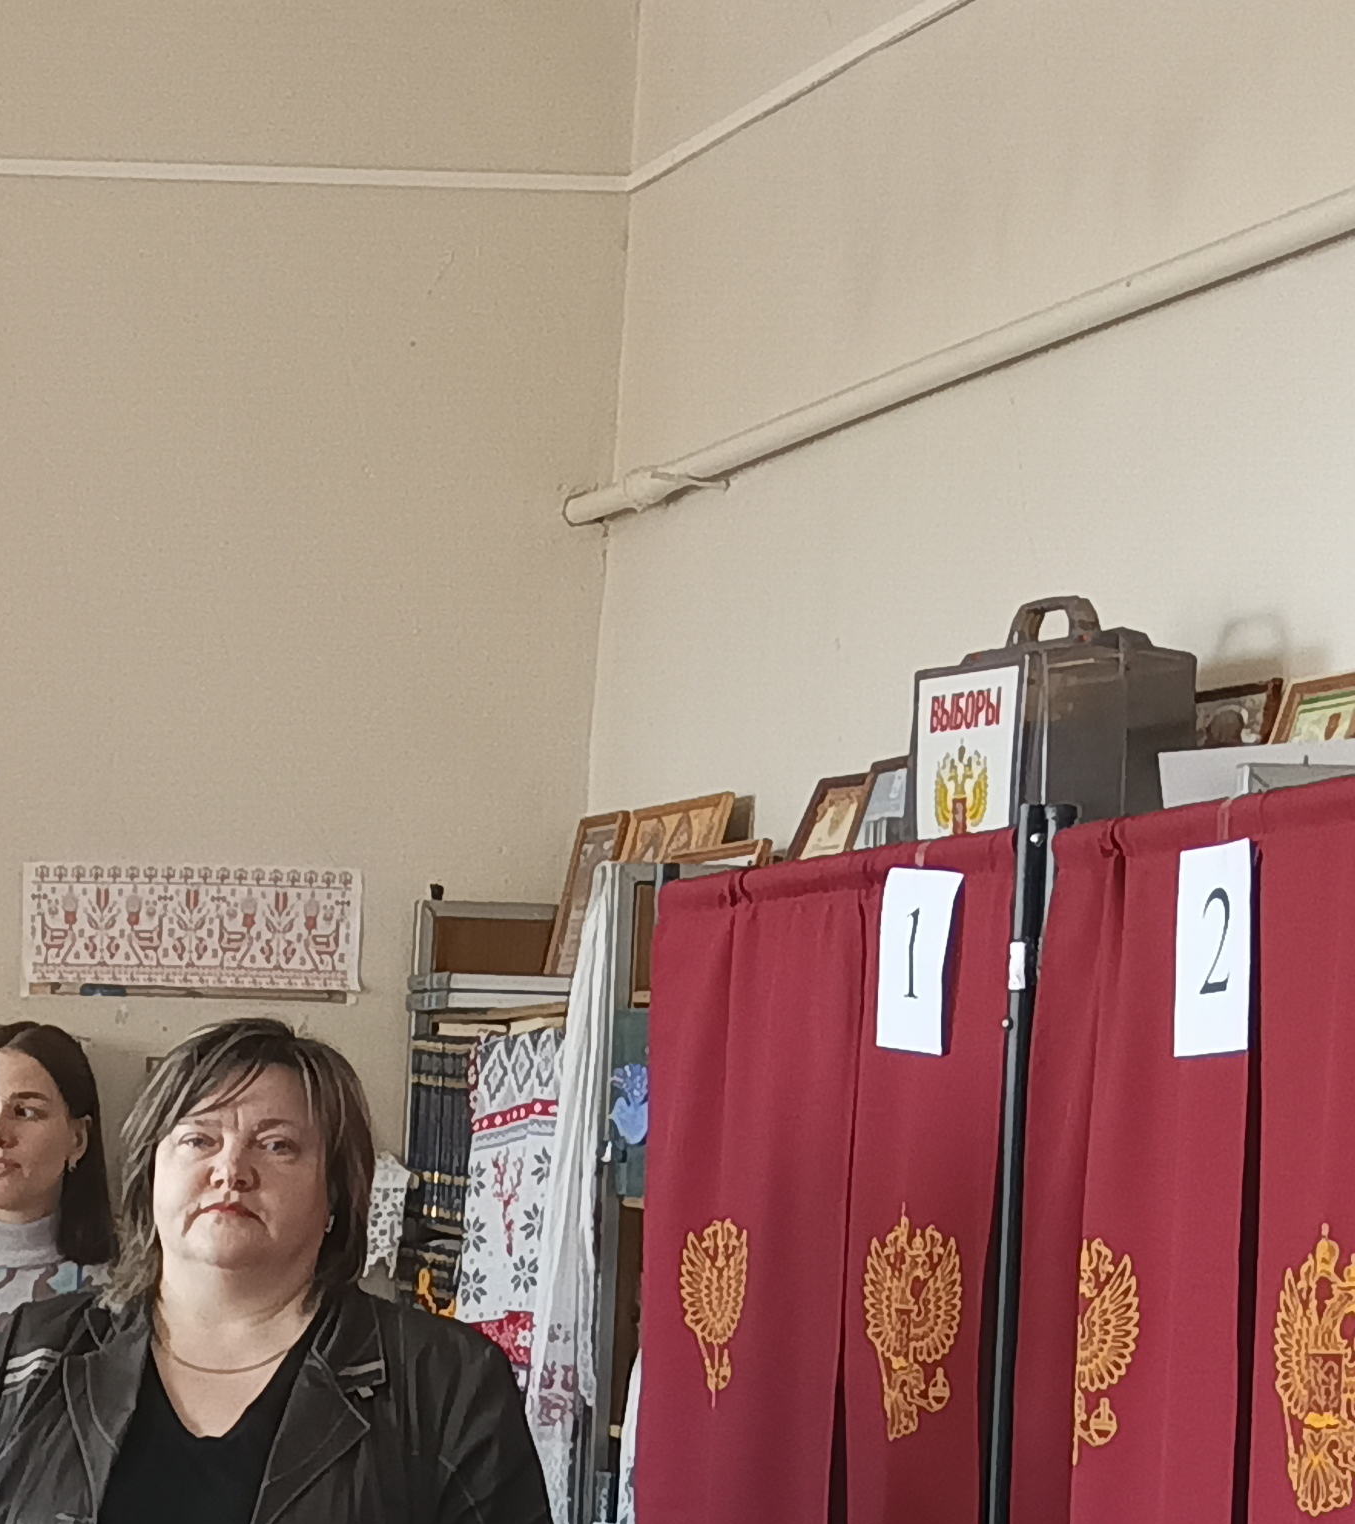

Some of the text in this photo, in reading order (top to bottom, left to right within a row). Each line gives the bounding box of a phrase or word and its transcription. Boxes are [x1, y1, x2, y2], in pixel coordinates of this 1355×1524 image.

[929, 685, 1002, 734] ВЫБОРЫ
[903, 906, 921, 999] 1
[1199, 887, 1231, 995] 2
